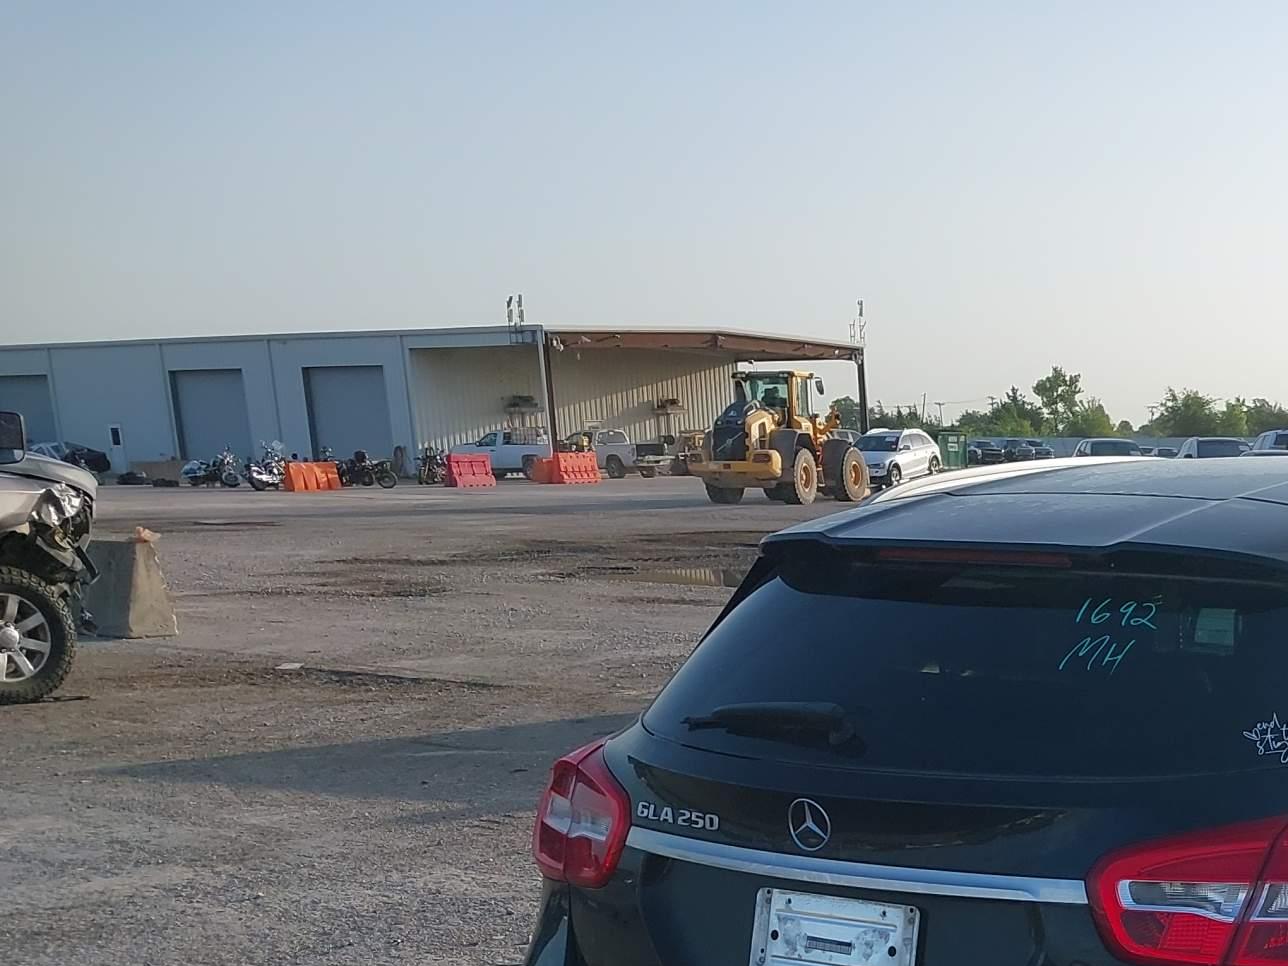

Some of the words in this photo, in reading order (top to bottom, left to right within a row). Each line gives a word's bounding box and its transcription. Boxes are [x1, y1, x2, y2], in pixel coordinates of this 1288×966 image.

[1075, 597, 1158, 630] 1692
[1058, 635, 1136, 674] MH
[1256, 711, 1281, 729] end
[637, 801, 674, 824] GLA
[677, 809, 720, 831] 250
